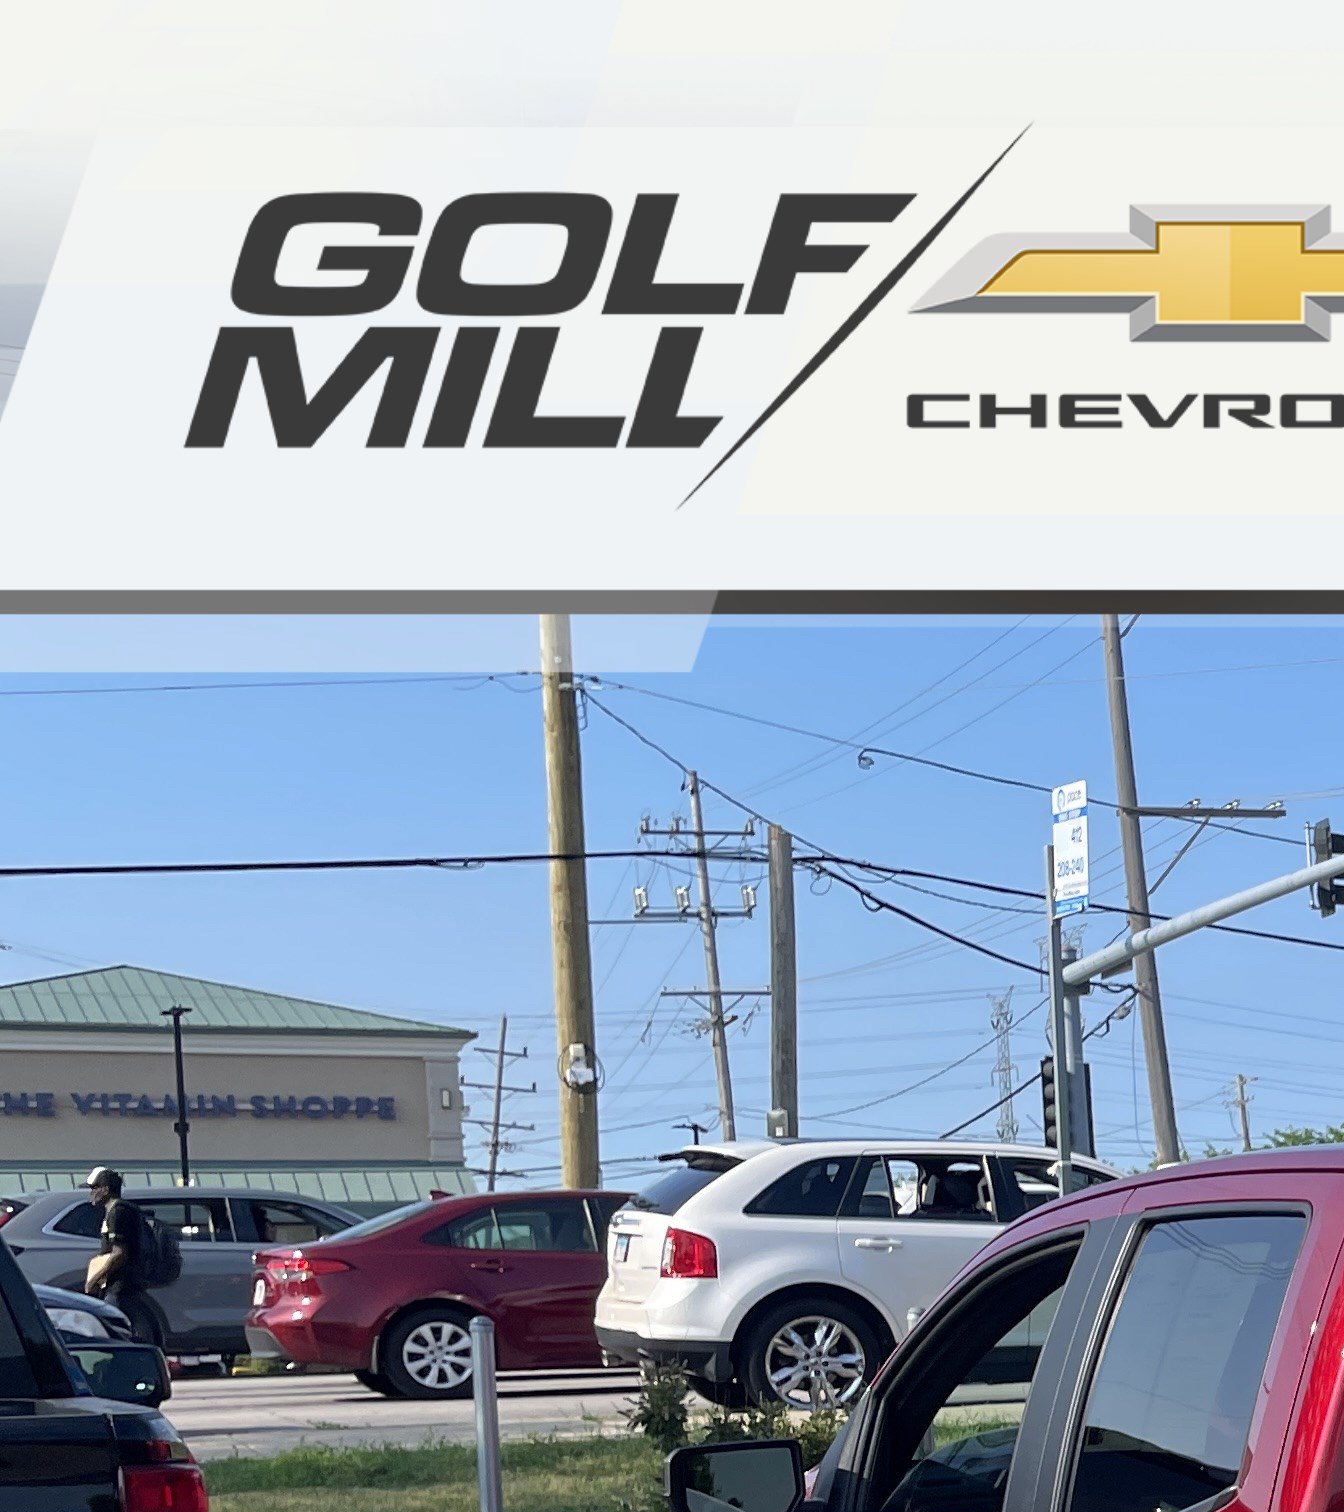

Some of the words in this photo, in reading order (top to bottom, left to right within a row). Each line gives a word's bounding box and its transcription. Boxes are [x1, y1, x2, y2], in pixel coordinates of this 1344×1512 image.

[0, 1091, 55, 1117] HE
[71, 1091, 237, 1118] VITAMIN
[250, 1095, 397, 1121] SHOPPE
